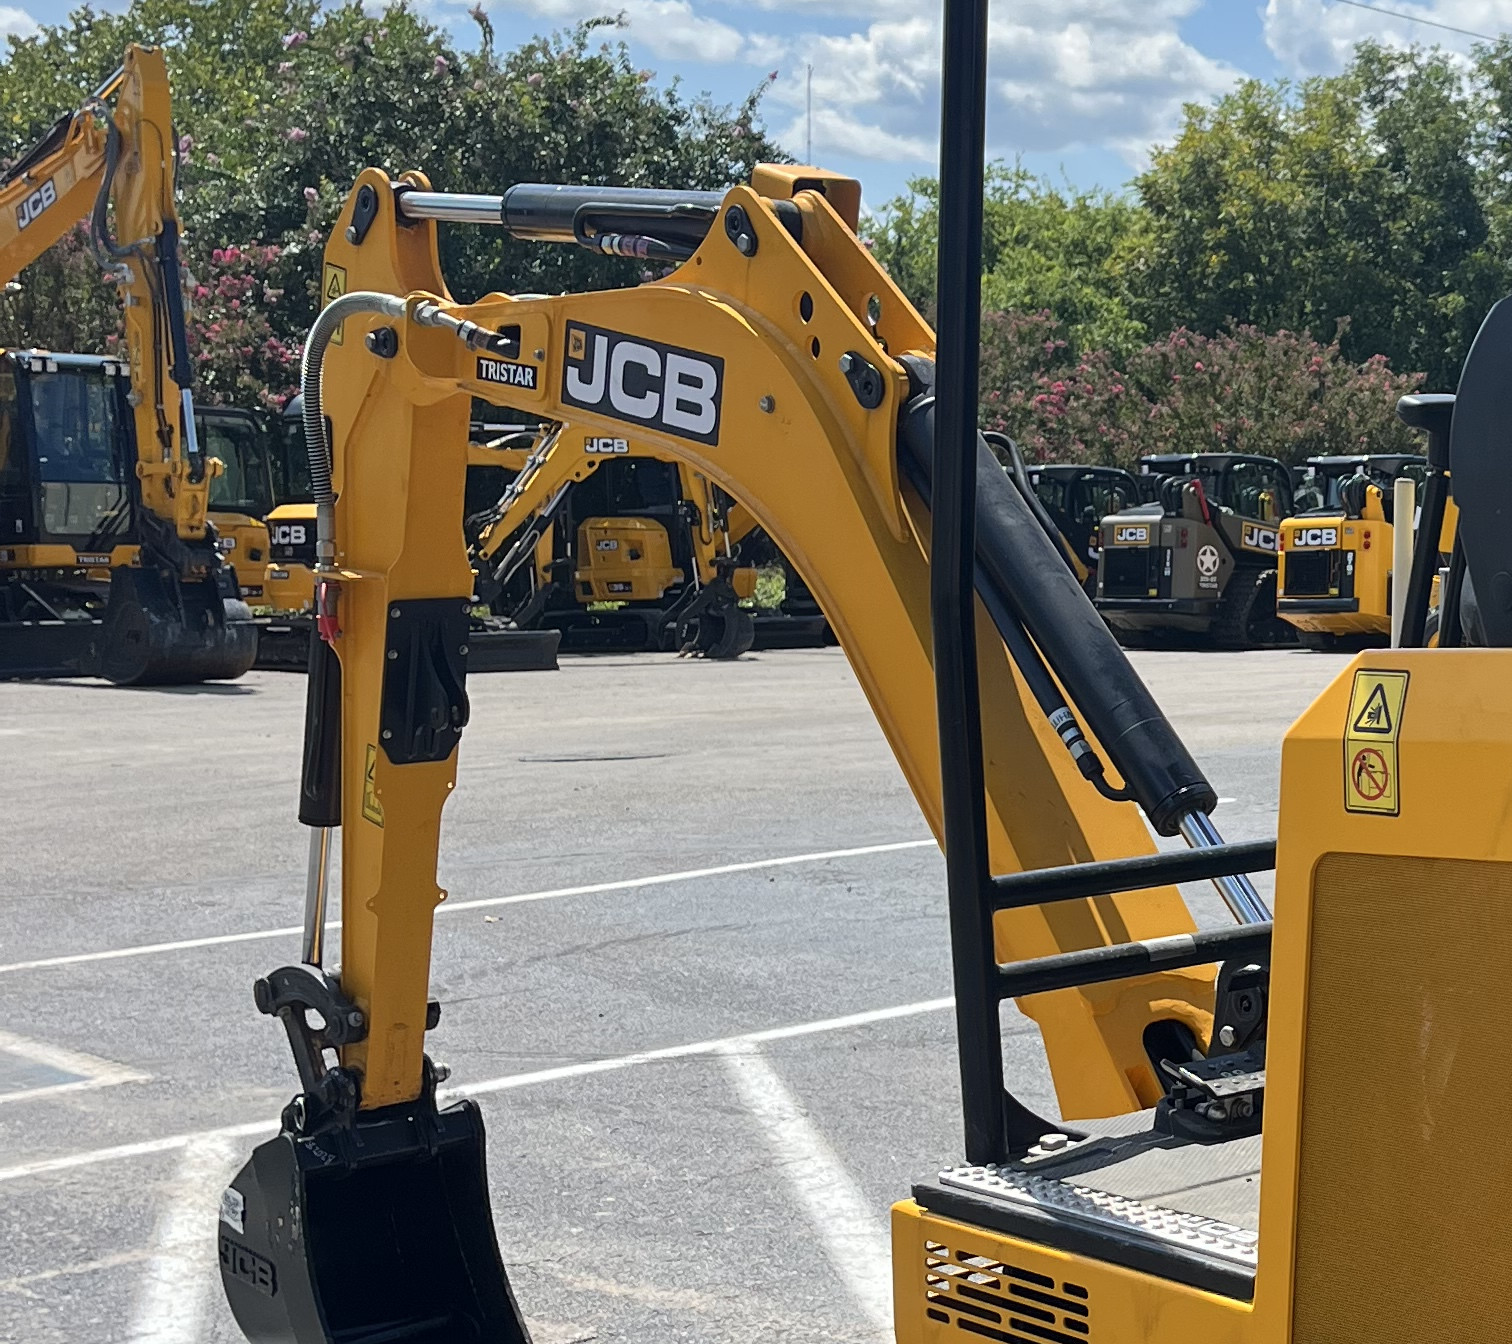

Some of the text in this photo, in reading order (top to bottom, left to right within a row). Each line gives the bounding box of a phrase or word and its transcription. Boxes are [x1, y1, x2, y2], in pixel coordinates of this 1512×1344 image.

[18, 179, 57, 229] JCB
[479, 359, 534, 387] TRISTAR
[566, 334, 717, 435] JCB
[585, 437, 629, 453] JCB
[595, 539, 618, 551] JCB
[1117, 528, 1147, 541] JCB
[1244, 527, 1279, 551] JC
[1294, 528, 1337, 546] JCB
